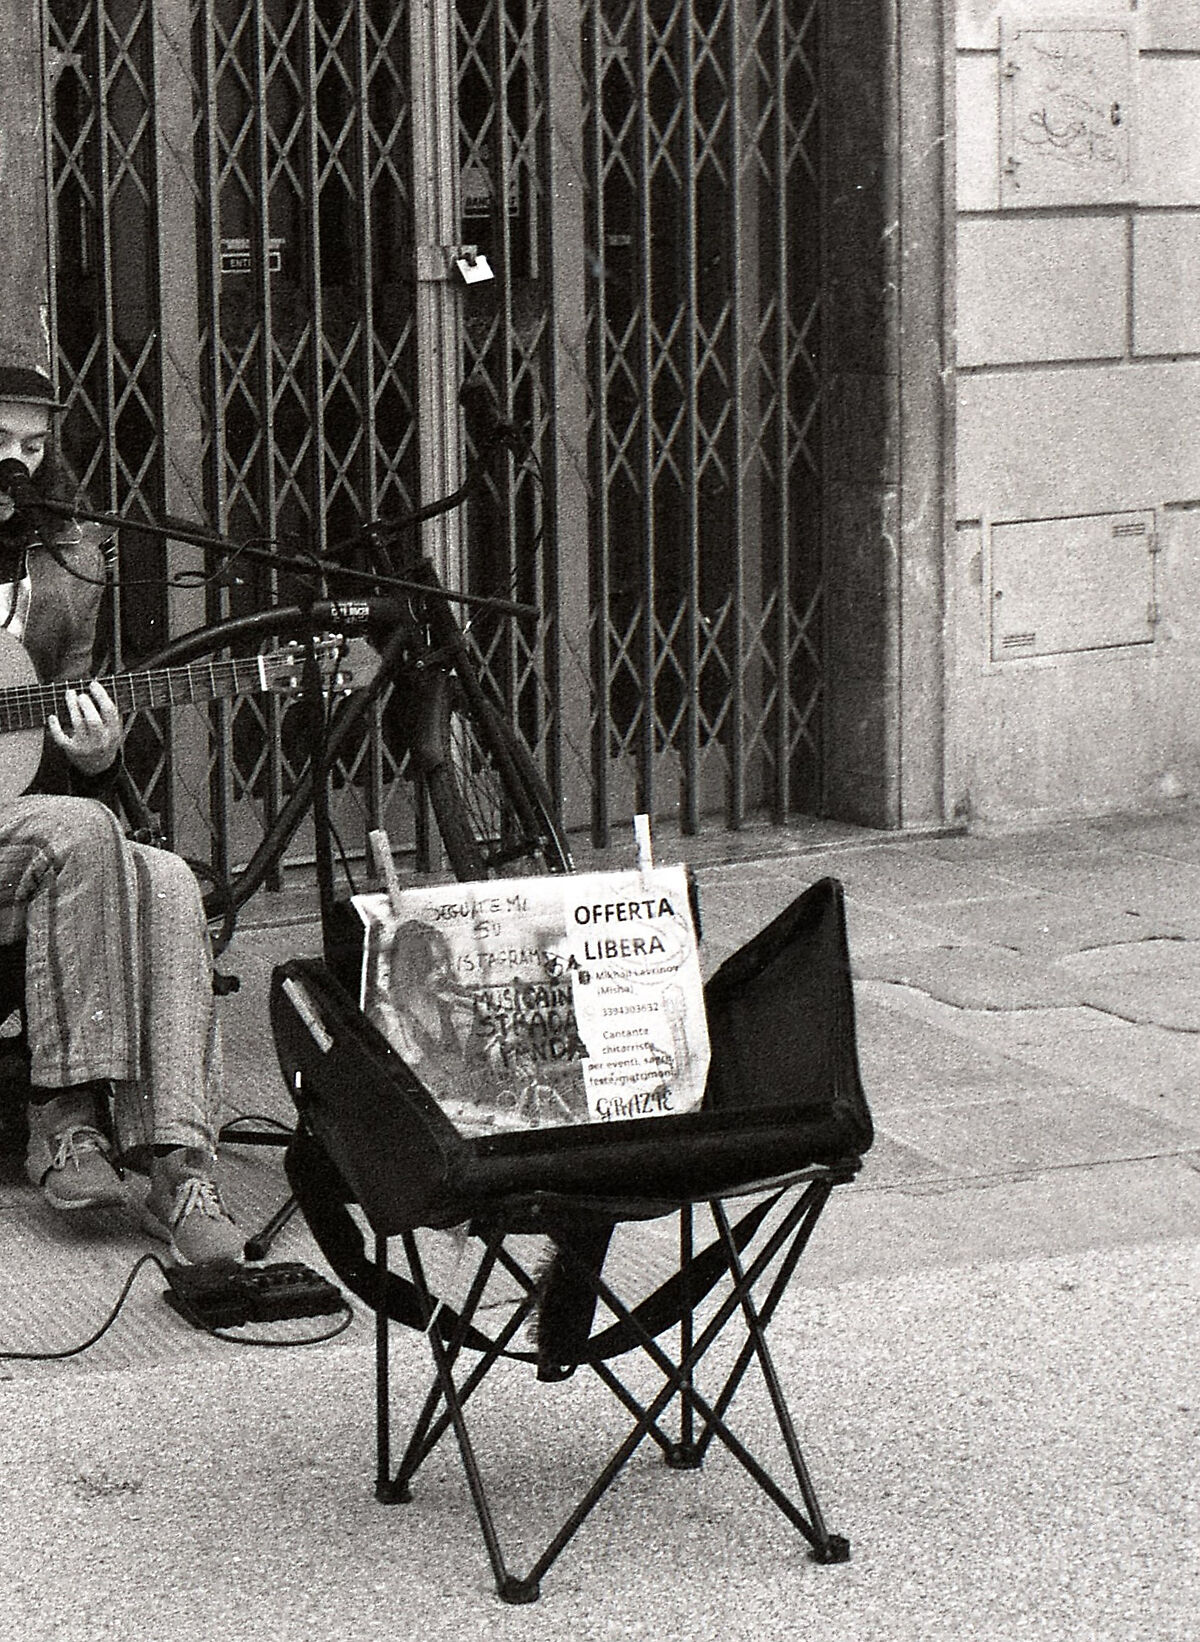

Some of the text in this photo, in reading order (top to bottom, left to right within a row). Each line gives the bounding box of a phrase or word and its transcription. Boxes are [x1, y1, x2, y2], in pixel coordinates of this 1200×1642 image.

[574, 897, 675, 925] OFFERTA
[584, 935, 666, 960] LIBERA
[602, 1028, 649, 1040] Cantante
[595, 1089, 674, 1121] GRAZIE
